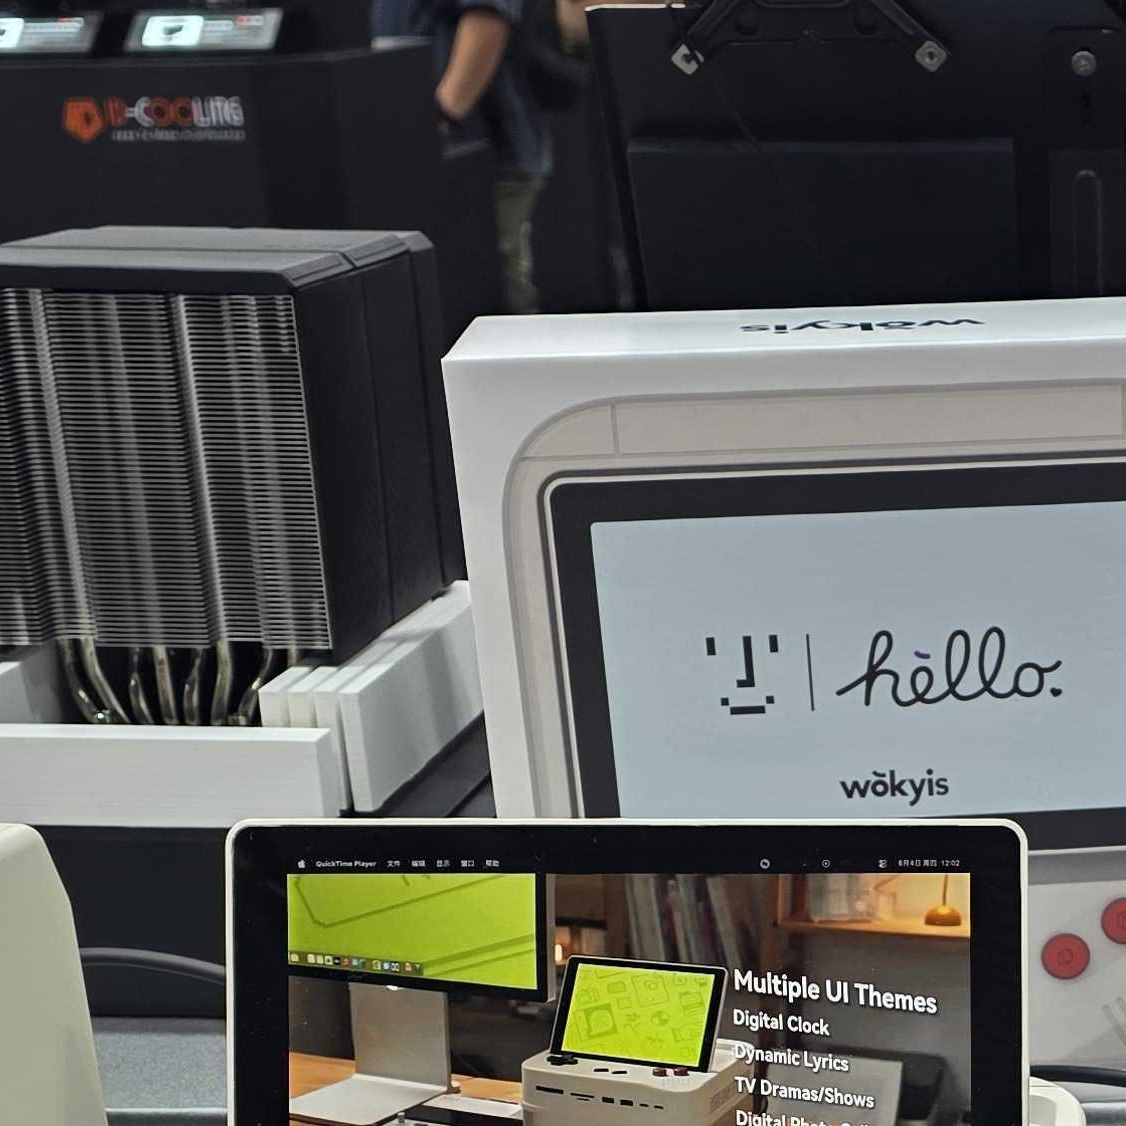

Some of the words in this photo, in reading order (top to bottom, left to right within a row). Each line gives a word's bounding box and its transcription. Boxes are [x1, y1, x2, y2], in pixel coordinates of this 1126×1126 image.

[734, 969, 819, 1002] Multiple
[826, 980, 848, 1003] UI
[854, 982, 938, 1014] Themes
[734, 1009, 783, 1032] Digital
[787, 1015, 830, 1036] Clock
[734, 1044, 800, 1065] Dynamic
[804, 1051, 849, 1073] Lyrics
[734, 1077, 756, 1094] TV
[760, 1079, 875, 1108] Dramas/Shows
